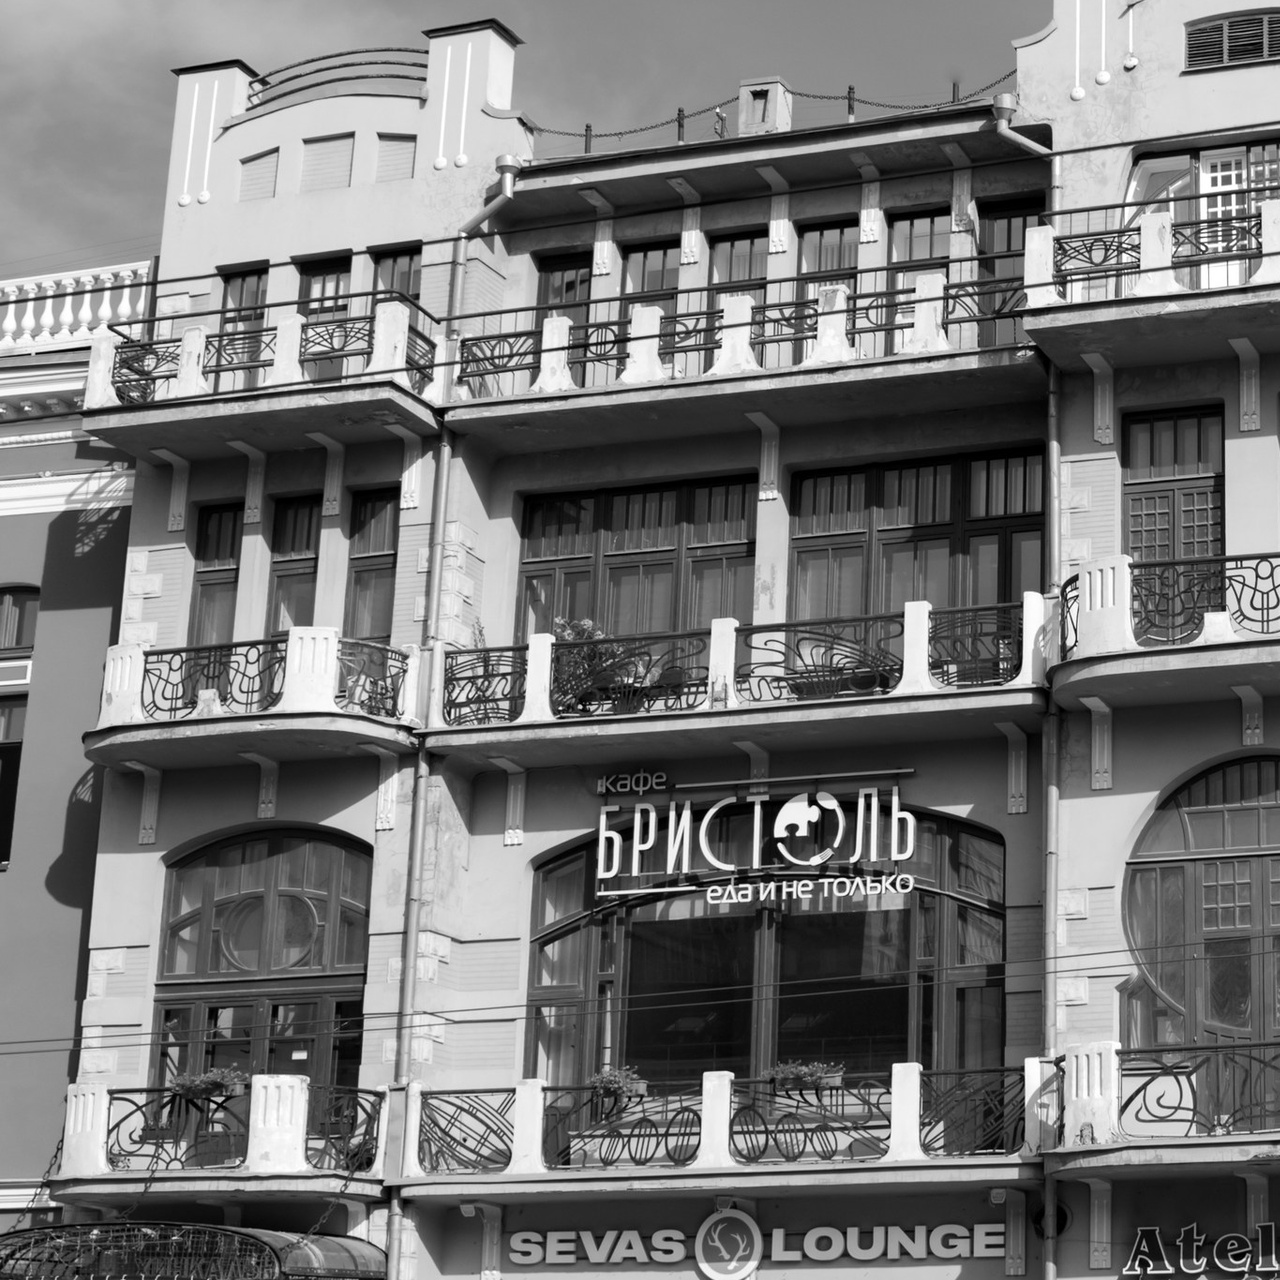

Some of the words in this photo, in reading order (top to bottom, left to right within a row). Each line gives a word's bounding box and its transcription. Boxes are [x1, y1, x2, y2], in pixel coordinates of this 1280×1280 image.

[602, 769, 667, 796] кафе
[597, 786, 917, 879] БРИСТОЛЬ
[707, 884, 752, 904] еда
[760, 883, 776, 900] и
[782, 879, 813, 899] не
[819, 874, 915, 897] только
[509, 1229, 687, 1264] SEVAS
[771, 1223, 1006, 1262] LOUNGE
